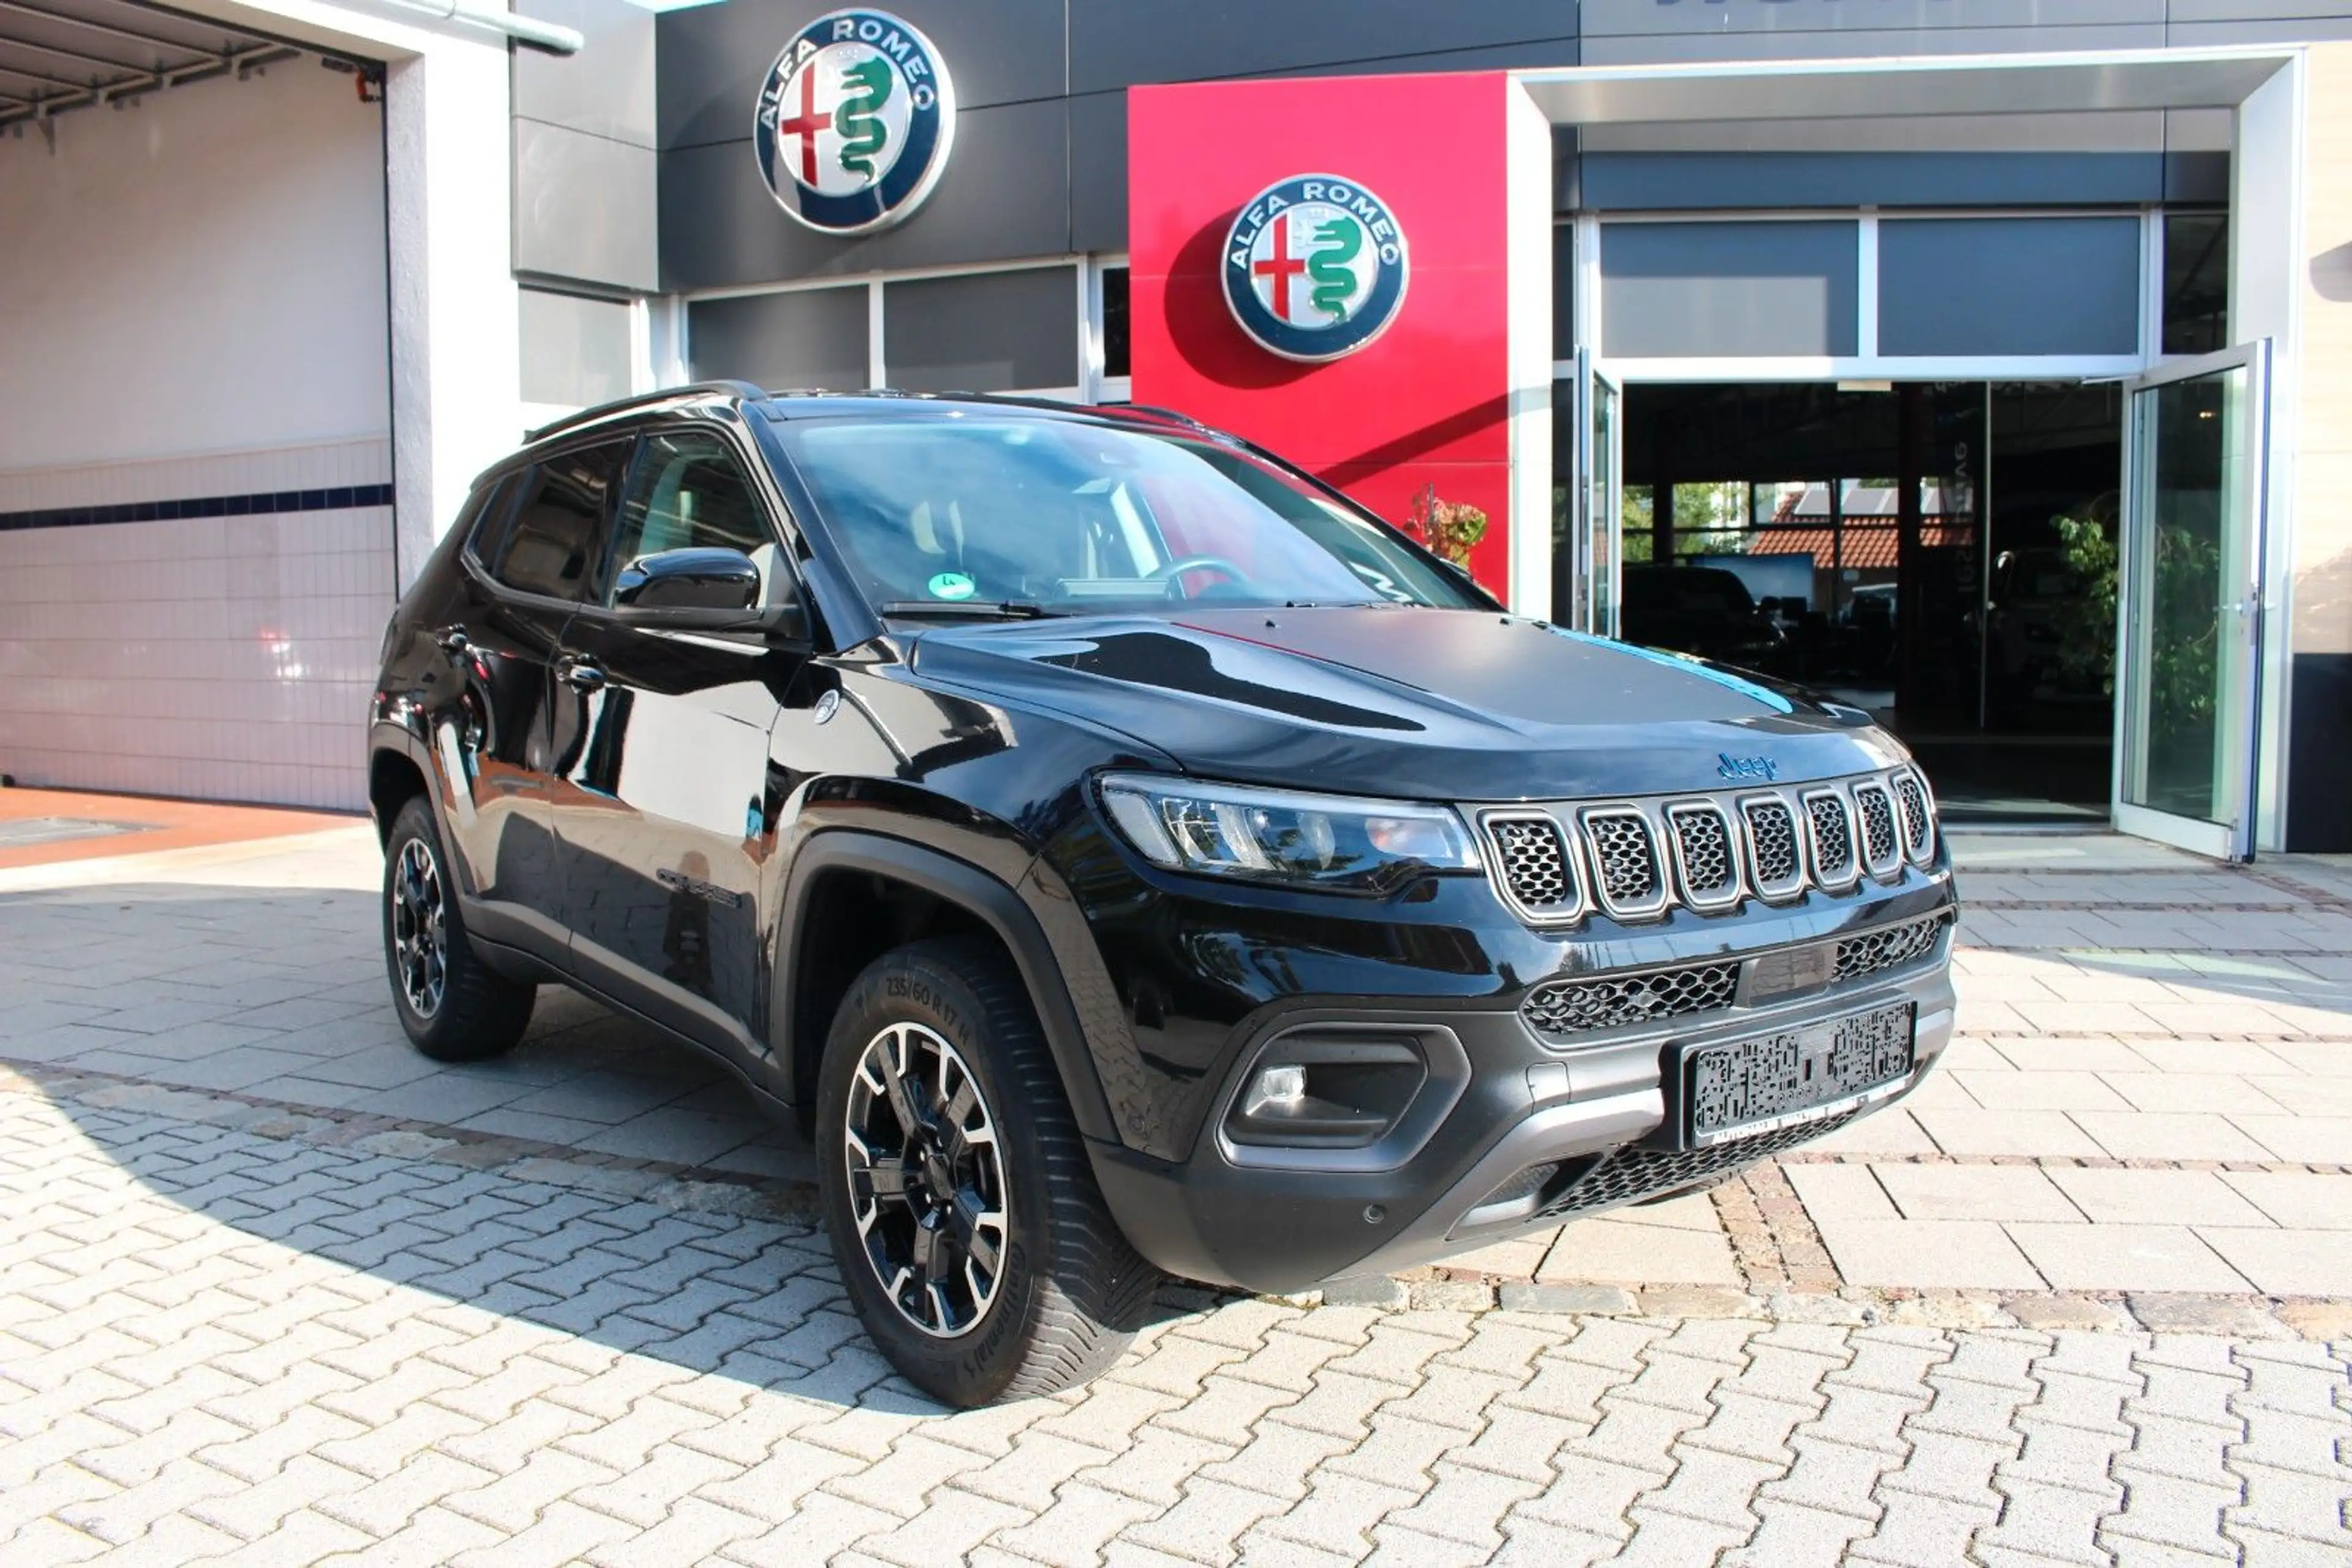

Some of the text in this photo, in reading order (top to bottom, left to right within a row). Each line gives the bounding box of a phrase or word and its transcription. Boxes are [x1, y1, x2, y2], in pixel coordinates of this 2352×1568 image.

[760, 19, 934, 130] ALFA ROMEO
[1231, 182, 1400, 270] ALFA ROMEO
[1716, 752, 1776, 782] Jeep
[886, 976, 930, 1006] 235/60
